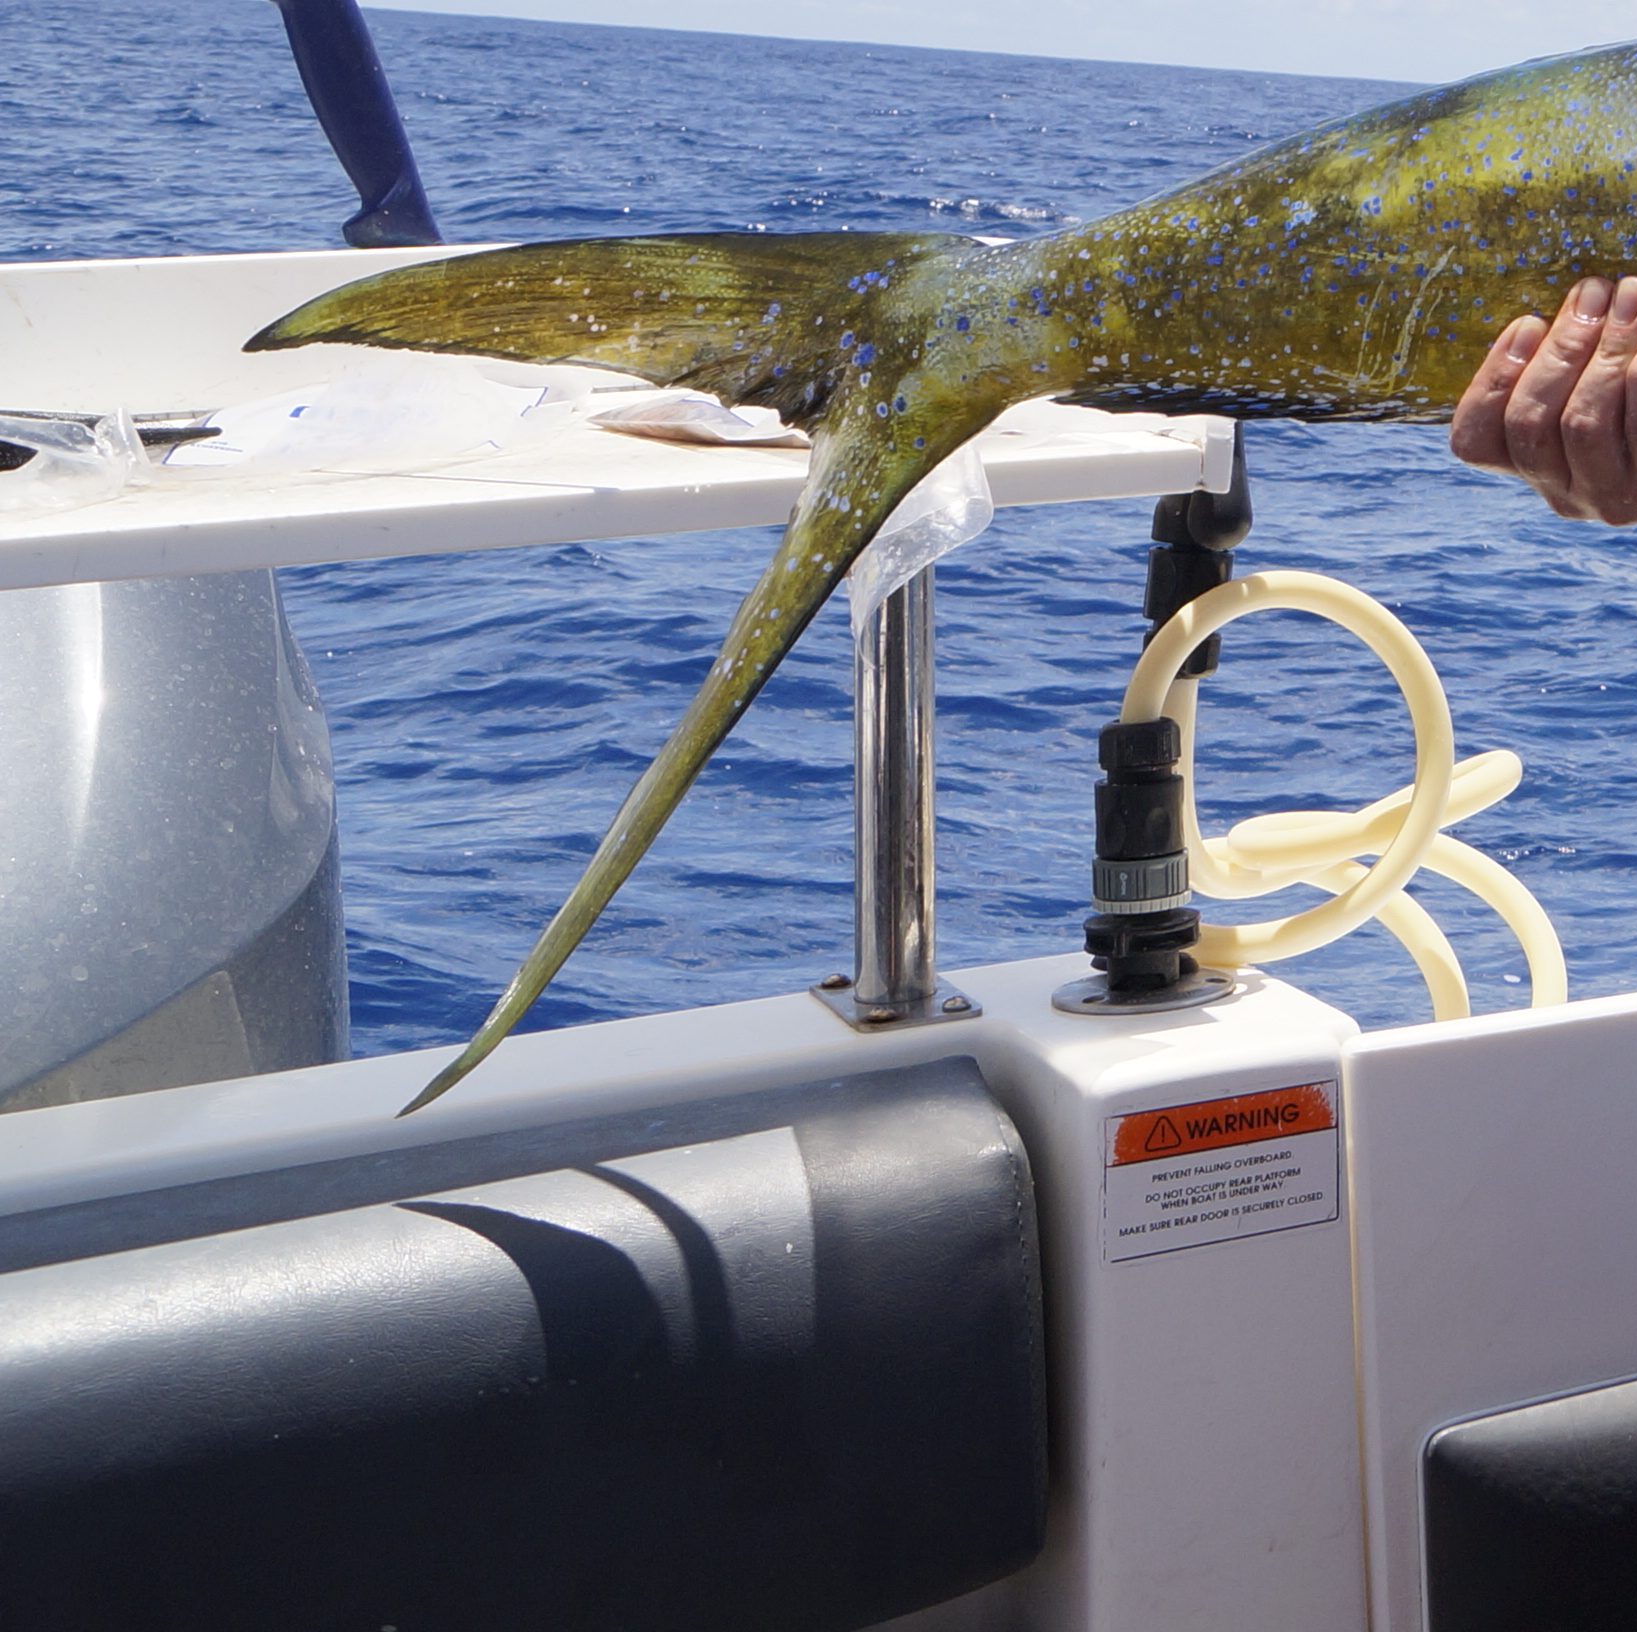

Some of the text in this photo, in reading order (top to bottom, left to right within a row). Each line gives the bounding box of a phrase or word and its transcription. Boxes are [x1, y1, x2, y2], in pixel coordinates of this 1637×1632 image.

[1186, 1103, 1299, 1139] WARNING
[1145, 1168, 1301, 1203] DO NOT OCCUPY REAR PLATFORM
[1152, 1168, 1191, 1183] PREVENT
[1194, 1161, 1232, 1175] FALLING
[1161, 1198, 1188, 1210] WHEN
[1191, 1192, 1216, 1205] BOAT
[1219, 1191, 1227, 1199] IS
[1229, 1185, 1260, 1197] UNDER
[1119, 1224, 1146, 1237] MAKE
[1149, 1220, 1171, 1231] SURE
[1174, 1215, 1198, 1226] REAR
[1200, 1209, 1229, 1222] DOOR
[1231, 1207, 1239, 1216] IS
[1241, 1198, 1285, 1214] SECURELY
